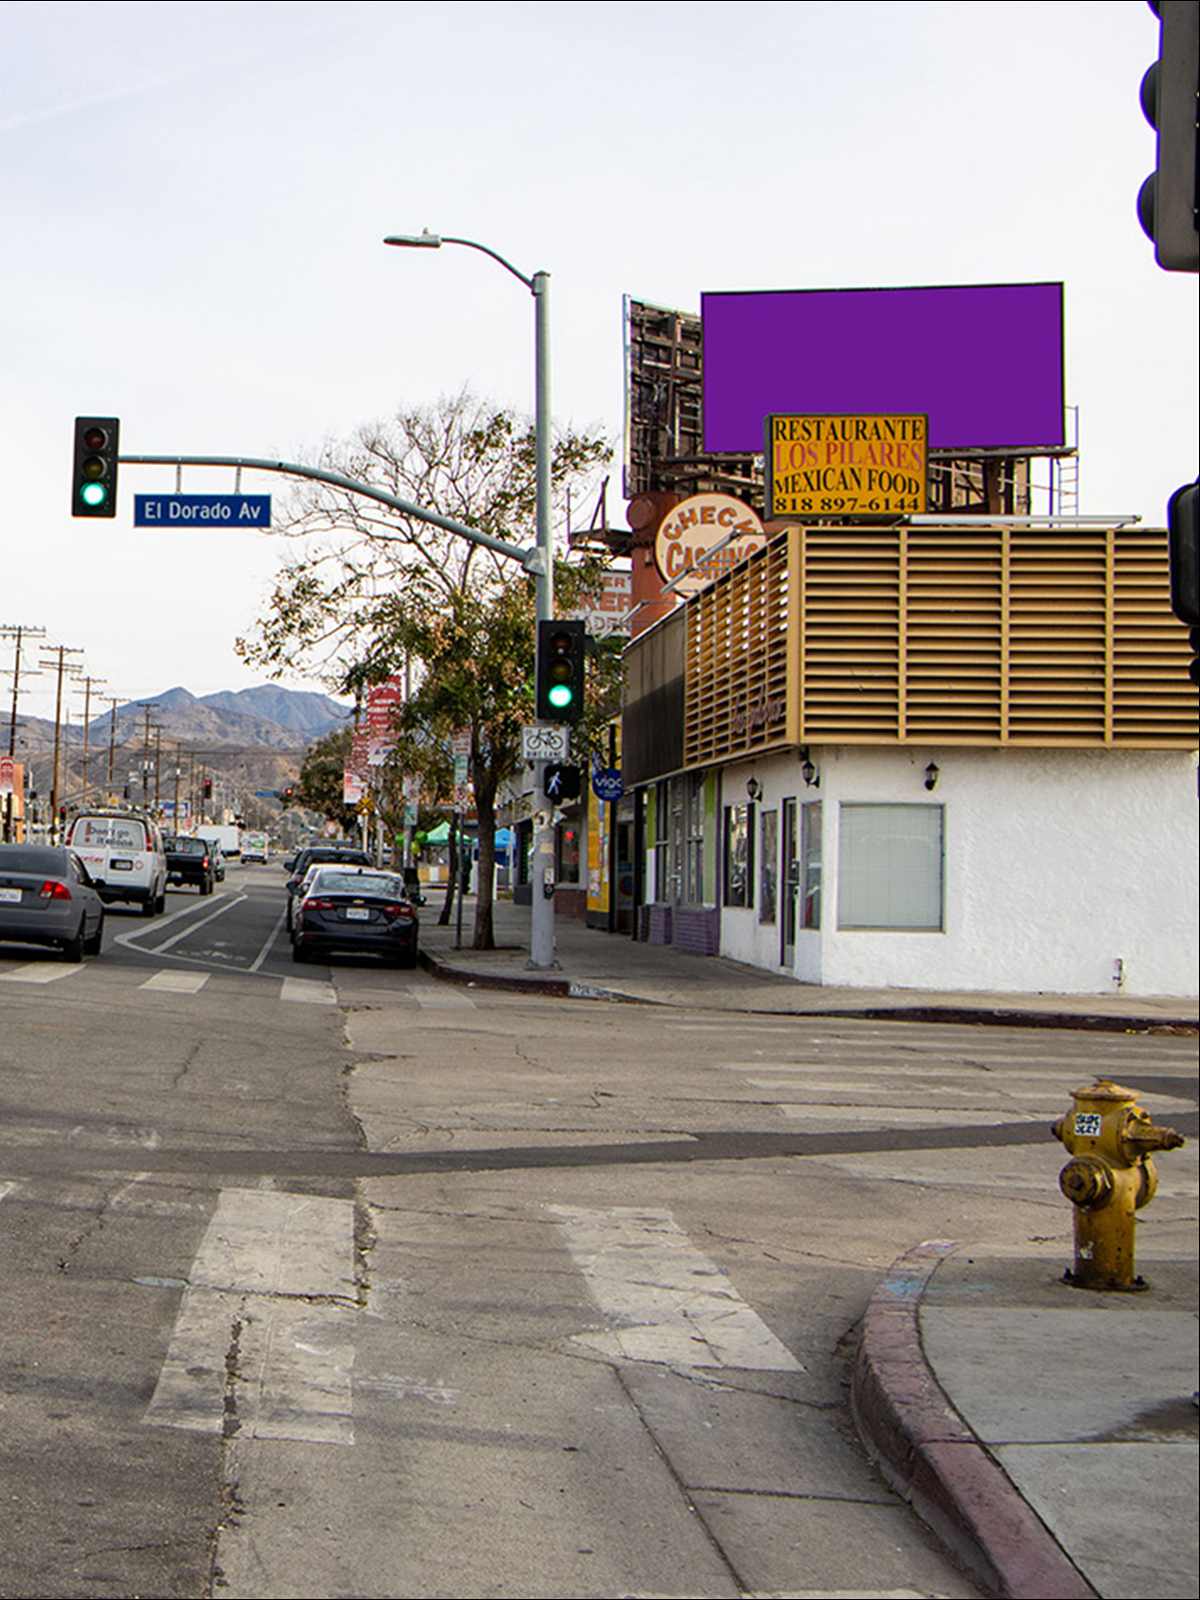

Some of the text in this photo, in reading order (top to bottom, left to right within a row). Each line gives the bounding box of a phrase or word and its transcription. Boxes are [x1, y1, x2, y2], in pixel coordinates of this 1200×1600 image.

[775, 419, 923, 441] RESTAURANTE
[775, 442, 923, 473] LOS PILARES
[775, 467, 920, 496] MEXICAN FOOD
[145, 502, 261, 519] El Dorado Av
[775, 498, 919, 511] 818 897-6144
[662, 505, 757, 542] CHECK
